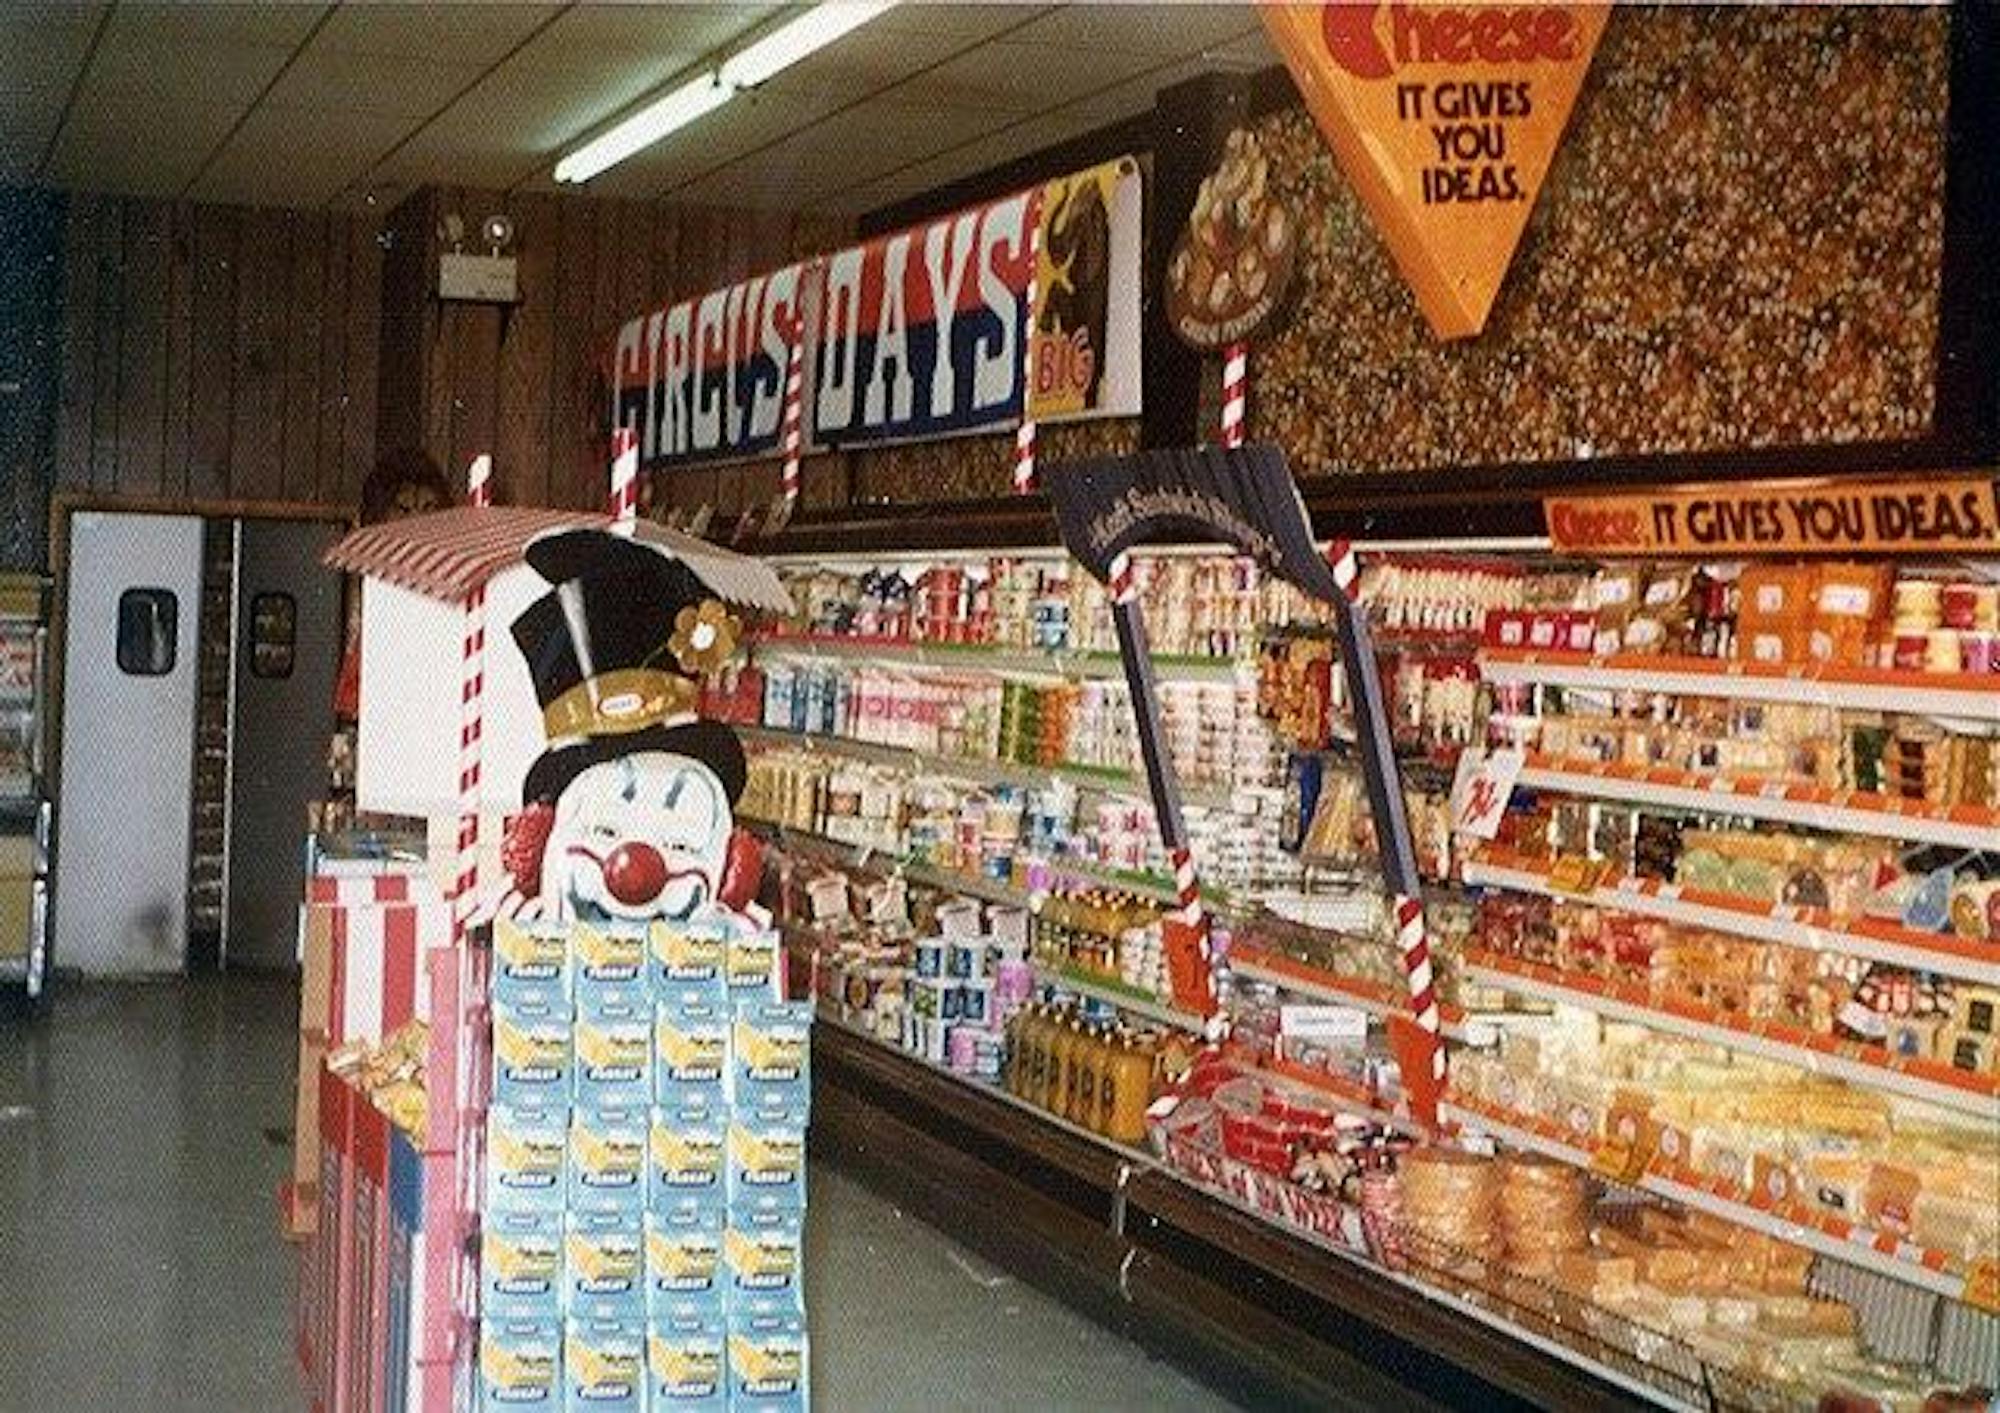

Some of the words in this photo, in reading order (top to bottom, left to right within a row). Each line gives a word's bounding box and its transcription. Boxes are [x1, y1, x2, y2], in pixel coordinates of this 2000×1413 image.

[1322, 4, 1574, 79] Cheese
[1398, 84, 1426, 119] IT
[1434, 82, 1532, 119] GIVES
[1433, 123, 1504, 162] YOU
[1423, 166, 1526, 204] IDEAS.
[614, 264, 802, 460] CIRCUS
[816, 197, 1030, 433] DAYS
[1652, 503, 1678, 544] IT
[1687, 500, 1785, 544] GIVES
[1790, 497, 1864, 542] YOU
[1871, 491, 1992, 541] IDEAS.
